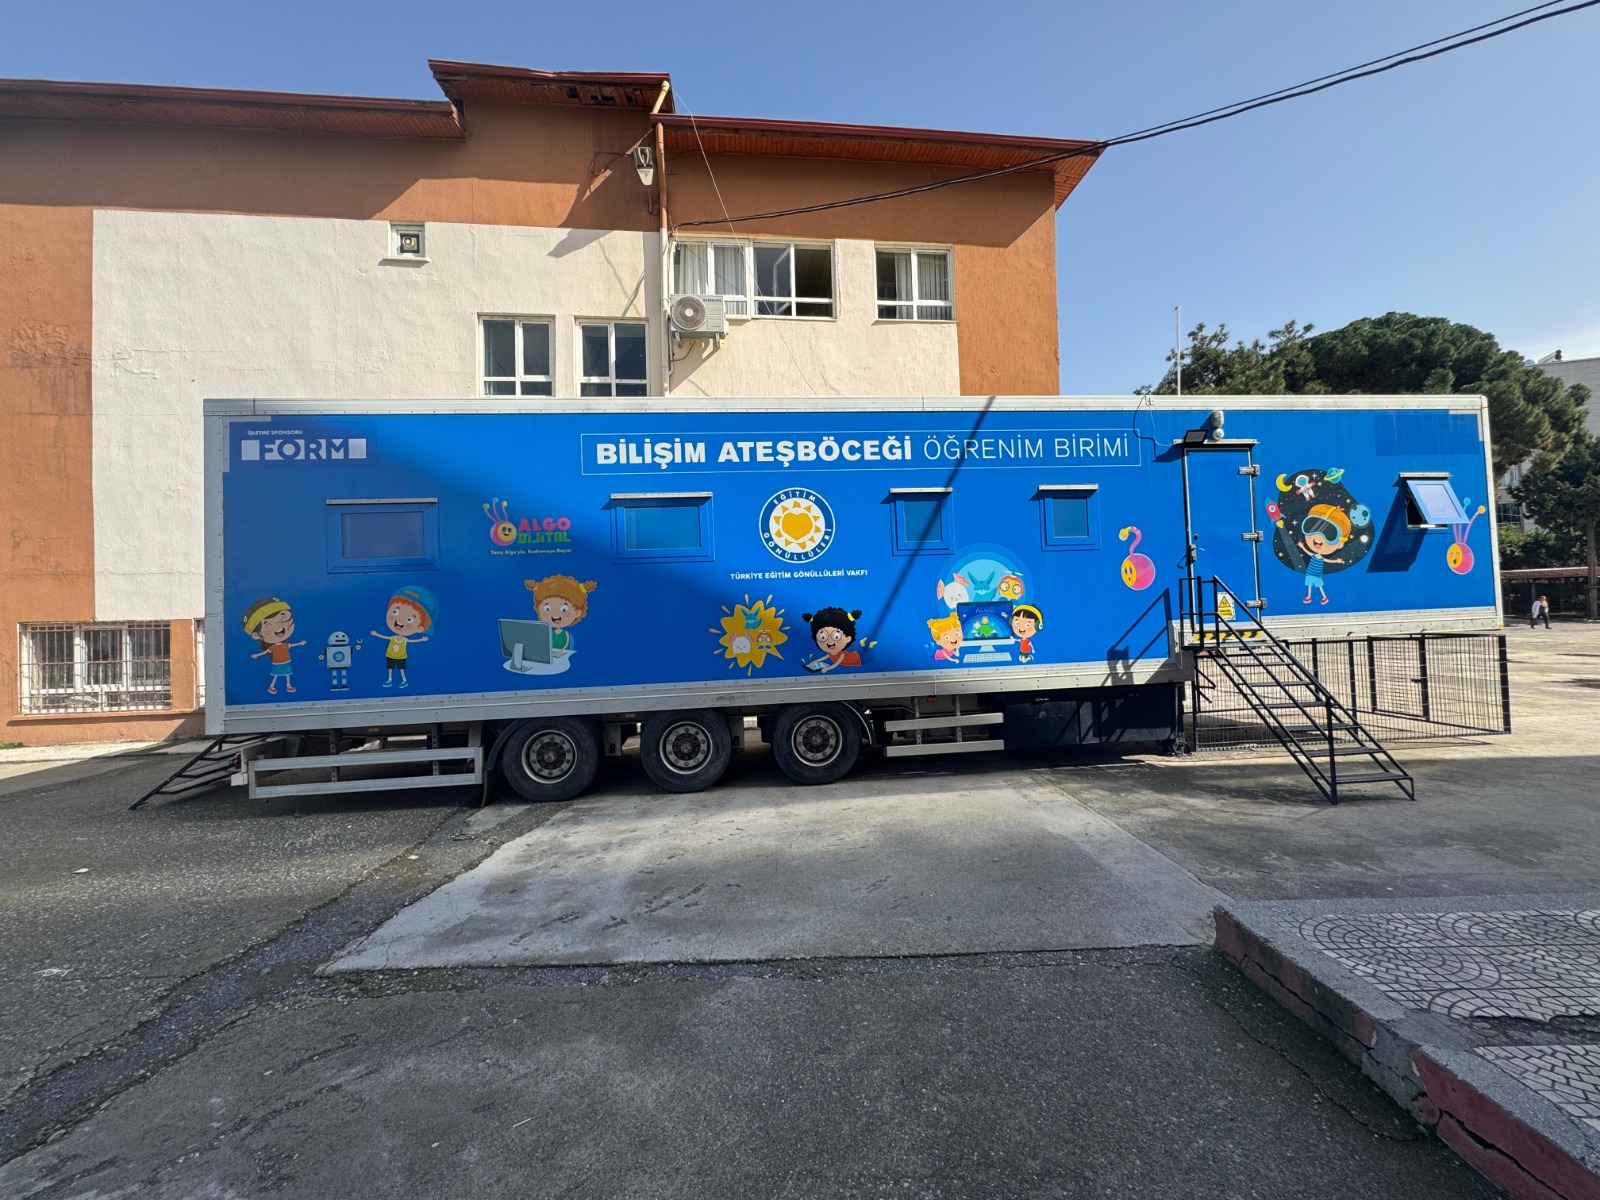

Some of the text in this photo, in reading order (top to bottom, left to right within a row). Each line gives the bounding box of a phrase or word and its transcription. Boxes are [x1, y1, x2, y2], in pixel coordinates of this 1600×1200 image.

[259, 438, 349, 460] FORM
[596, 433, 1129, 470] BİLİŞİM ATEŞBÖCEĞİ ÖĞRENİM BİRİMİ
[773, 490, 816, 505] EĞİTİM
[517, 517, 571, 531] ALGO
[517, 531, 572, 544] DİJİTAL
[763, 527, 833, 561] GÖNÜLLÜLERİ
[730, 571, 763, 580] TÜRKİYE
[764, 570, 791, 579] EĞİTİM
[793, 568, 845, 578] GÖNÜLLÜLERİ
